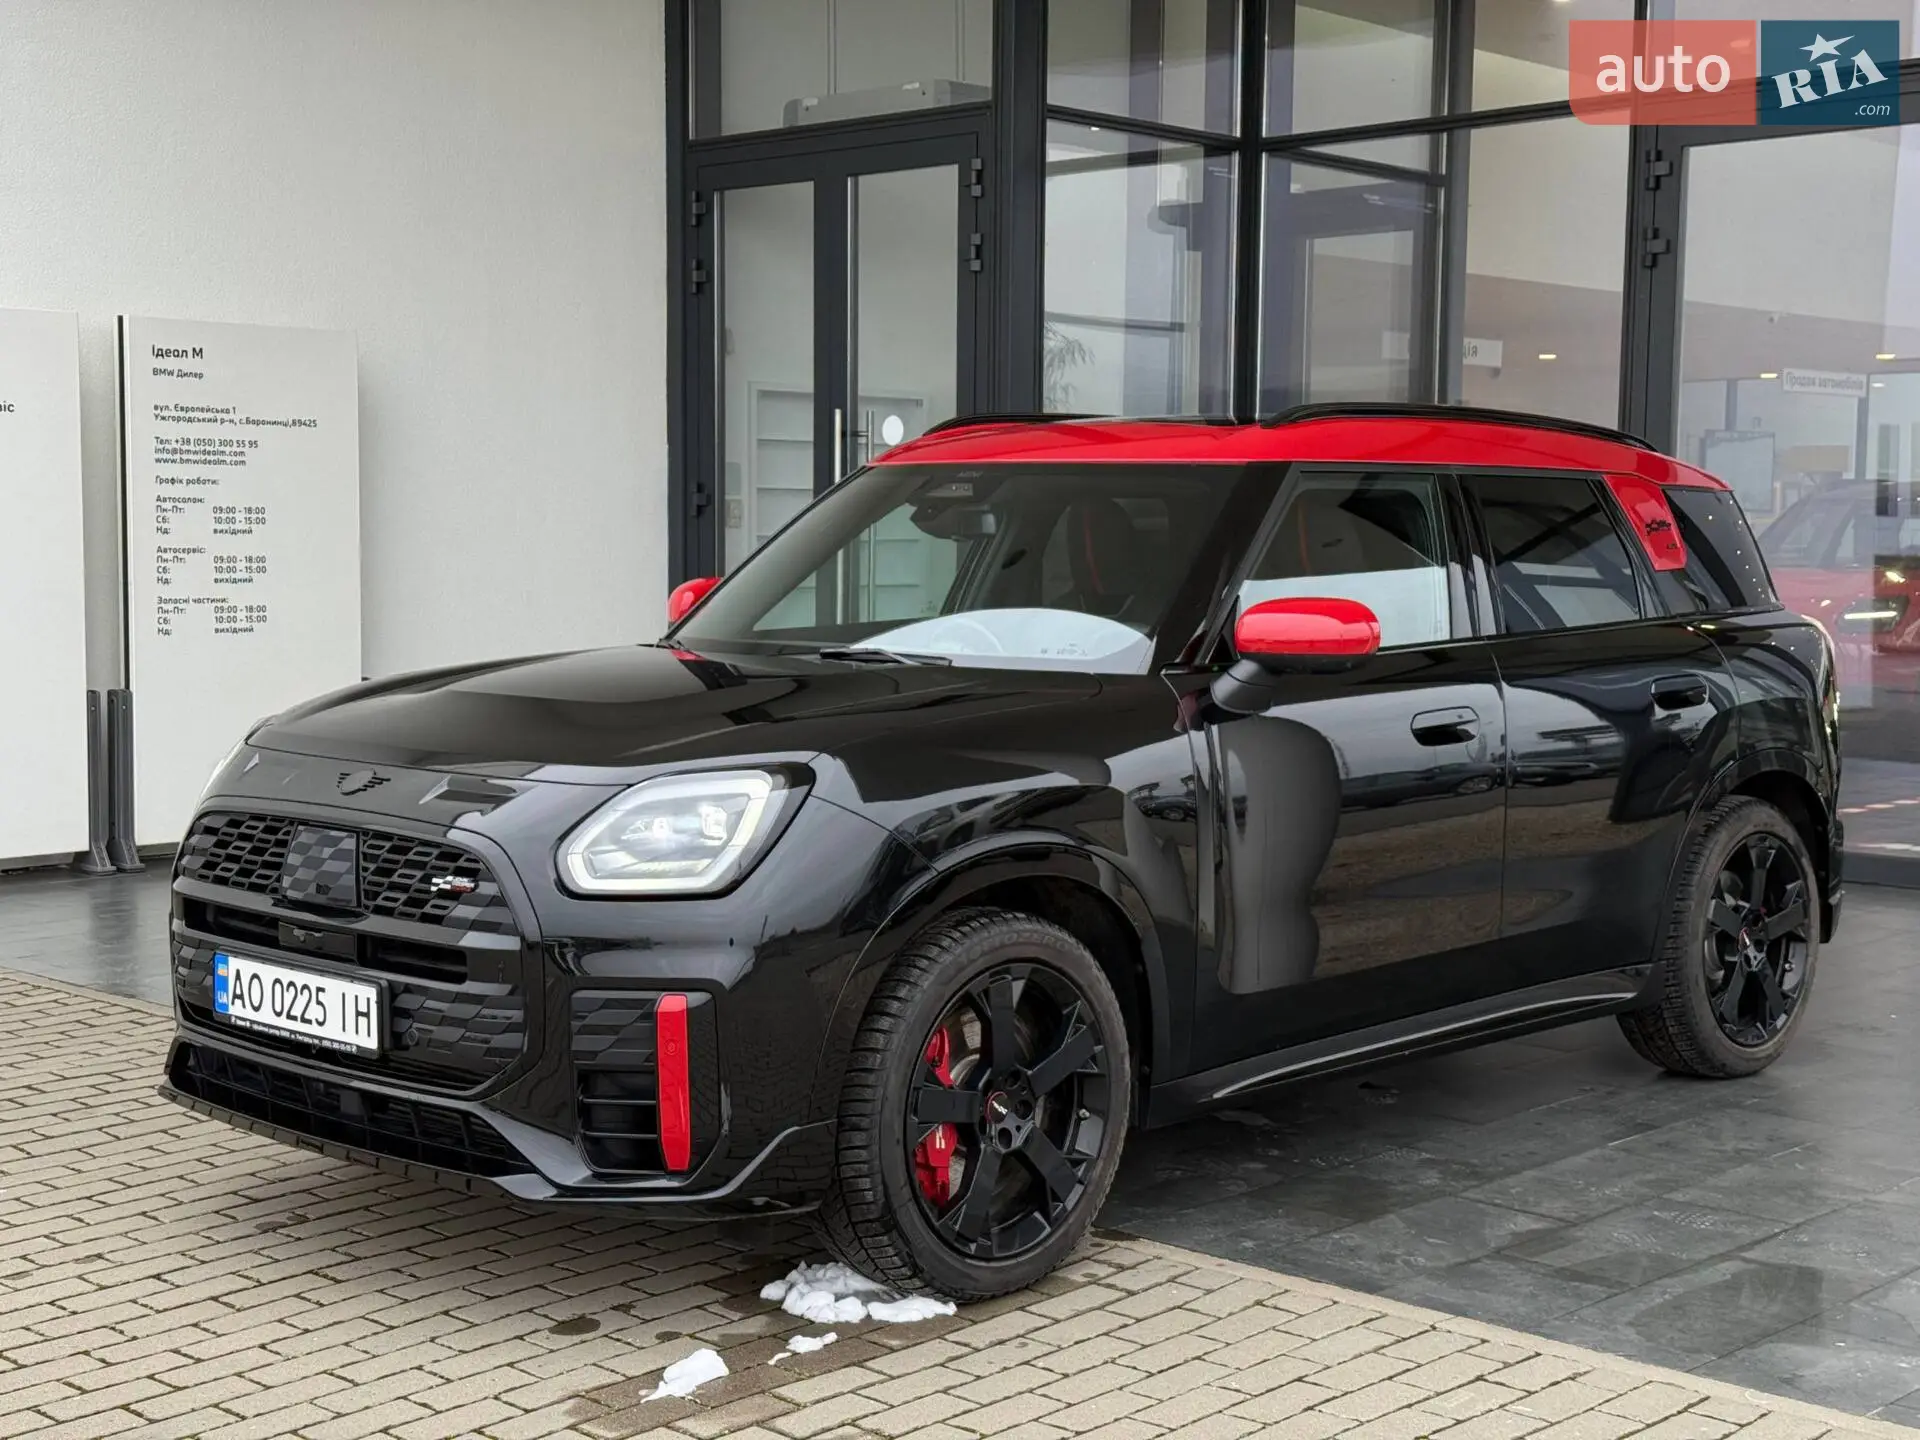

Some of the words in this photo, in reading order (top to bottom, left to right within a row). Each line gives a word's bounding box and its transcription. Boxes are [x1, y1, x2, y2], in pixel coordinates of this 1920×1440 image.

[152, 344, 188, 359] Ідеал
[152, 367, 175, 377] BMW
[176, 369, 204, 380] Дилер
[232, 406, 236, 415] 1
[154, 436, 172, 445] Тел:
[174, 437, 191, 446] +38
[193, 438, 216, 448] (050)
[217, 439, 234, 448] 300
[236, 440, 246, 448] 55
[247, 440, 259, 448] 95
[155, 475, 184, 486] Графік
[156, 495, 205, 504] Автосалон:
[212, 506, 237, 515] 09:00
[243, 506, 266, 515] 18:00
[156, 515, 170, 524] Сб:
[213, 517, 237, 525] 10:00
[244, 517, 266, 525] 15:00
[156, 526, 171, 535] Нд:
[213, 526, 253, 535] вихідний
[156, 545, 206, 555] Автосервіс:
[213, 556, 237, 564] 09:00
[244, 556, 267, 564] 18:00
[156, 566, 170, 574] Сб:
[214, 566, 237, 574] 10:00
[244, 566, 267, 574] 15:00
[157, 576, 171, 585] Нд:
[214, 576, 254, 585] вихідний
[157, 596, 190, 605] Запасні
[191, 597, 229, 605] частини:
[213, 605, 238, 614] 09:00
[245, 605, 267, 614] 18:00
[157, 617, 171, 625] Сб:
[214, 615, 238, 624] 10:00
[245, 615, 268, 624] 15:00
[157, 627, 172, 636] Нд:
[214, 625, 254, 634] вихідний
[217, 991, 228, 1004] UA
[231, 968, 264, 1013] AO
[271, 977, 327, 1027] 0225
[341, 991, 371, 1038] IH
